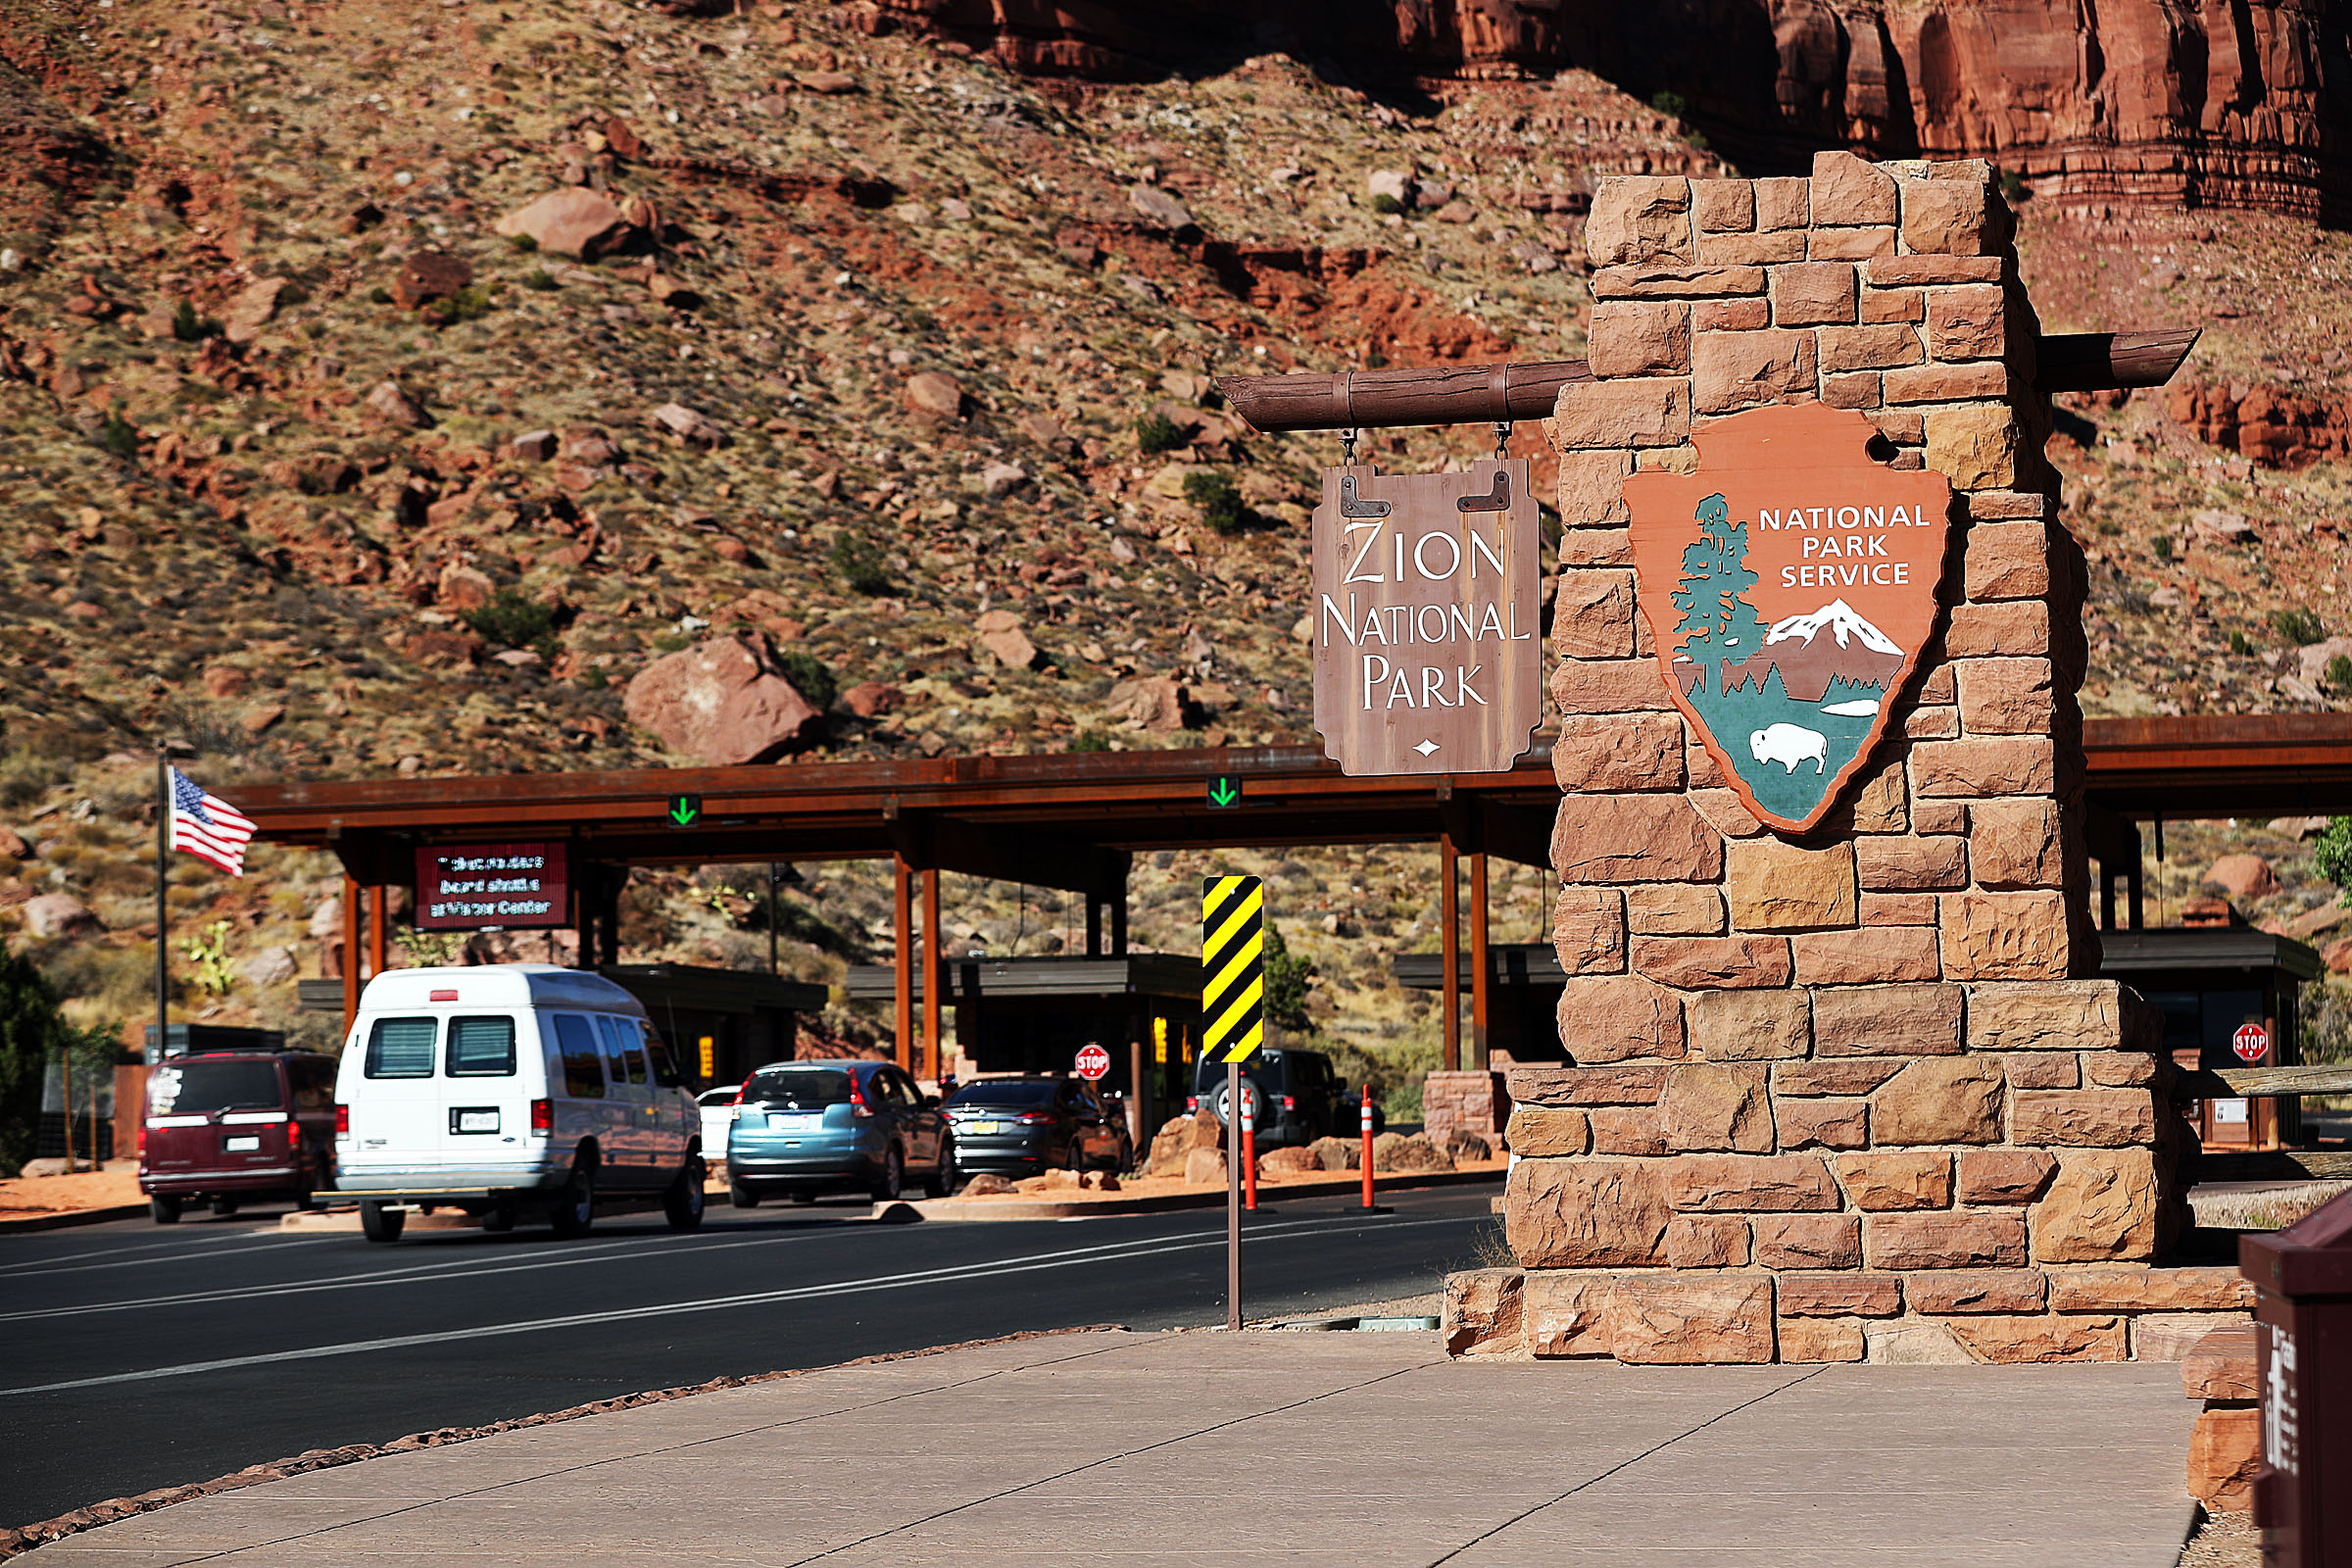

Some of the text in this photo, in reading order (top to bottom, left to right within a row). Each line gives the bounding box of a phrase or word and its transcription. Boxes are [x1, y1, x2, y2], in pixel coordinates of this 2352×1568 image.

[1759, 505, 1931, 531] NATIONAL
[1802, 534, 1888, 559] PARK
[1781, 563, 1910, 588] SERVICE
[498, 900, 552, 915] Center
[2235, 1035, 2266, 1050] STOP
[1077, 1055, 1107, 1069] STOP
